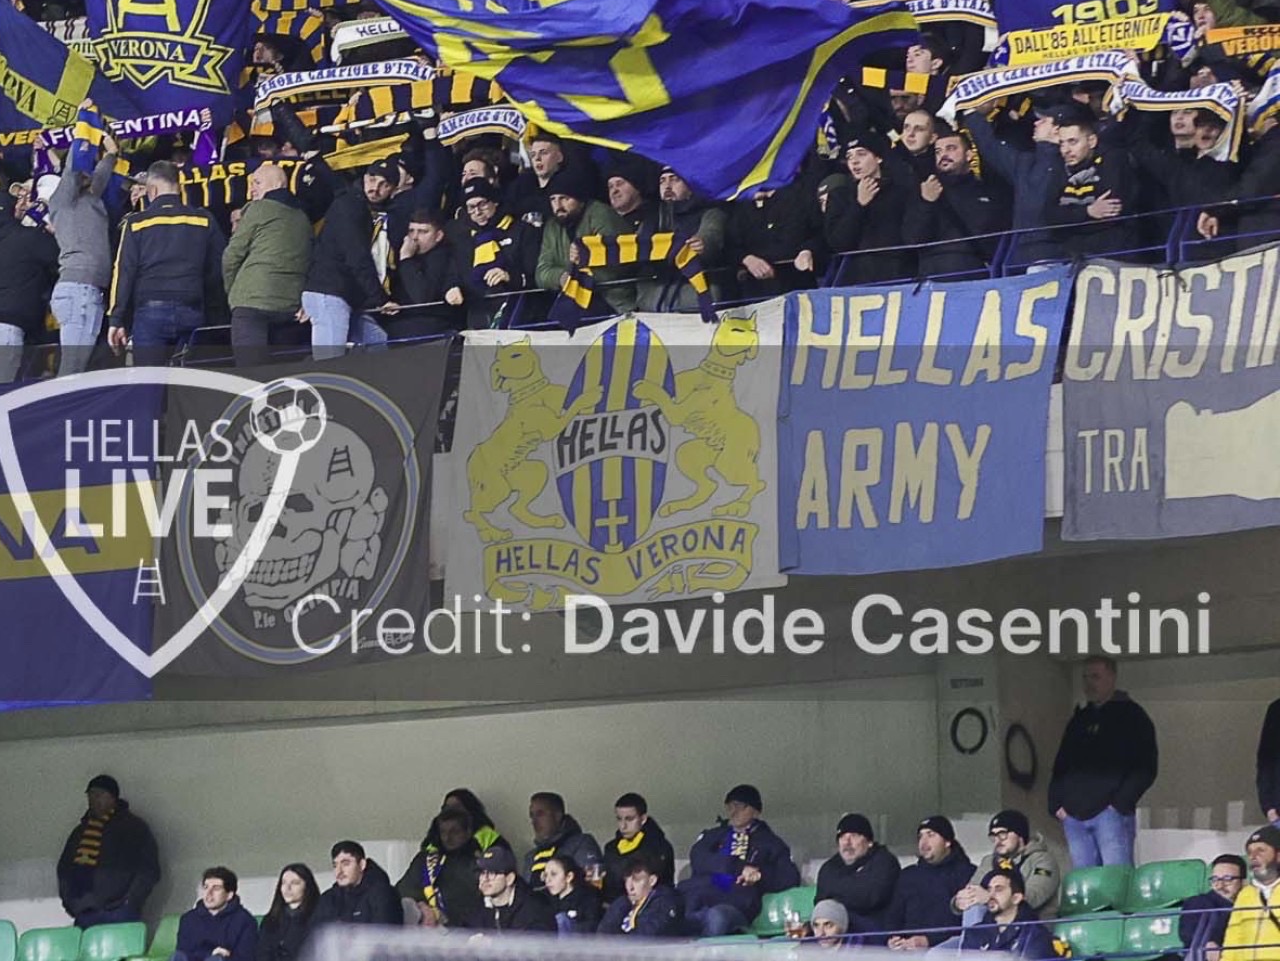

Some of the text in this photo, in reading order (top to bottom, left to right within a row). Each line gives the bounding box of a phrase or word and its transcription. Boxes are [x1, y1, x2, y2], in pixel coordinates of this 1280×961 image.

[111, 38, 187, 63] VERONA
[790, 279, 1060, 390] HELLAS
[557, 407, 668, 471] HELLAS
[1076, 426, 1150, 495] TRA
[796, 422, 992, 531] ARMY
[494, 525, 748, 586] HELLAS VERONA
